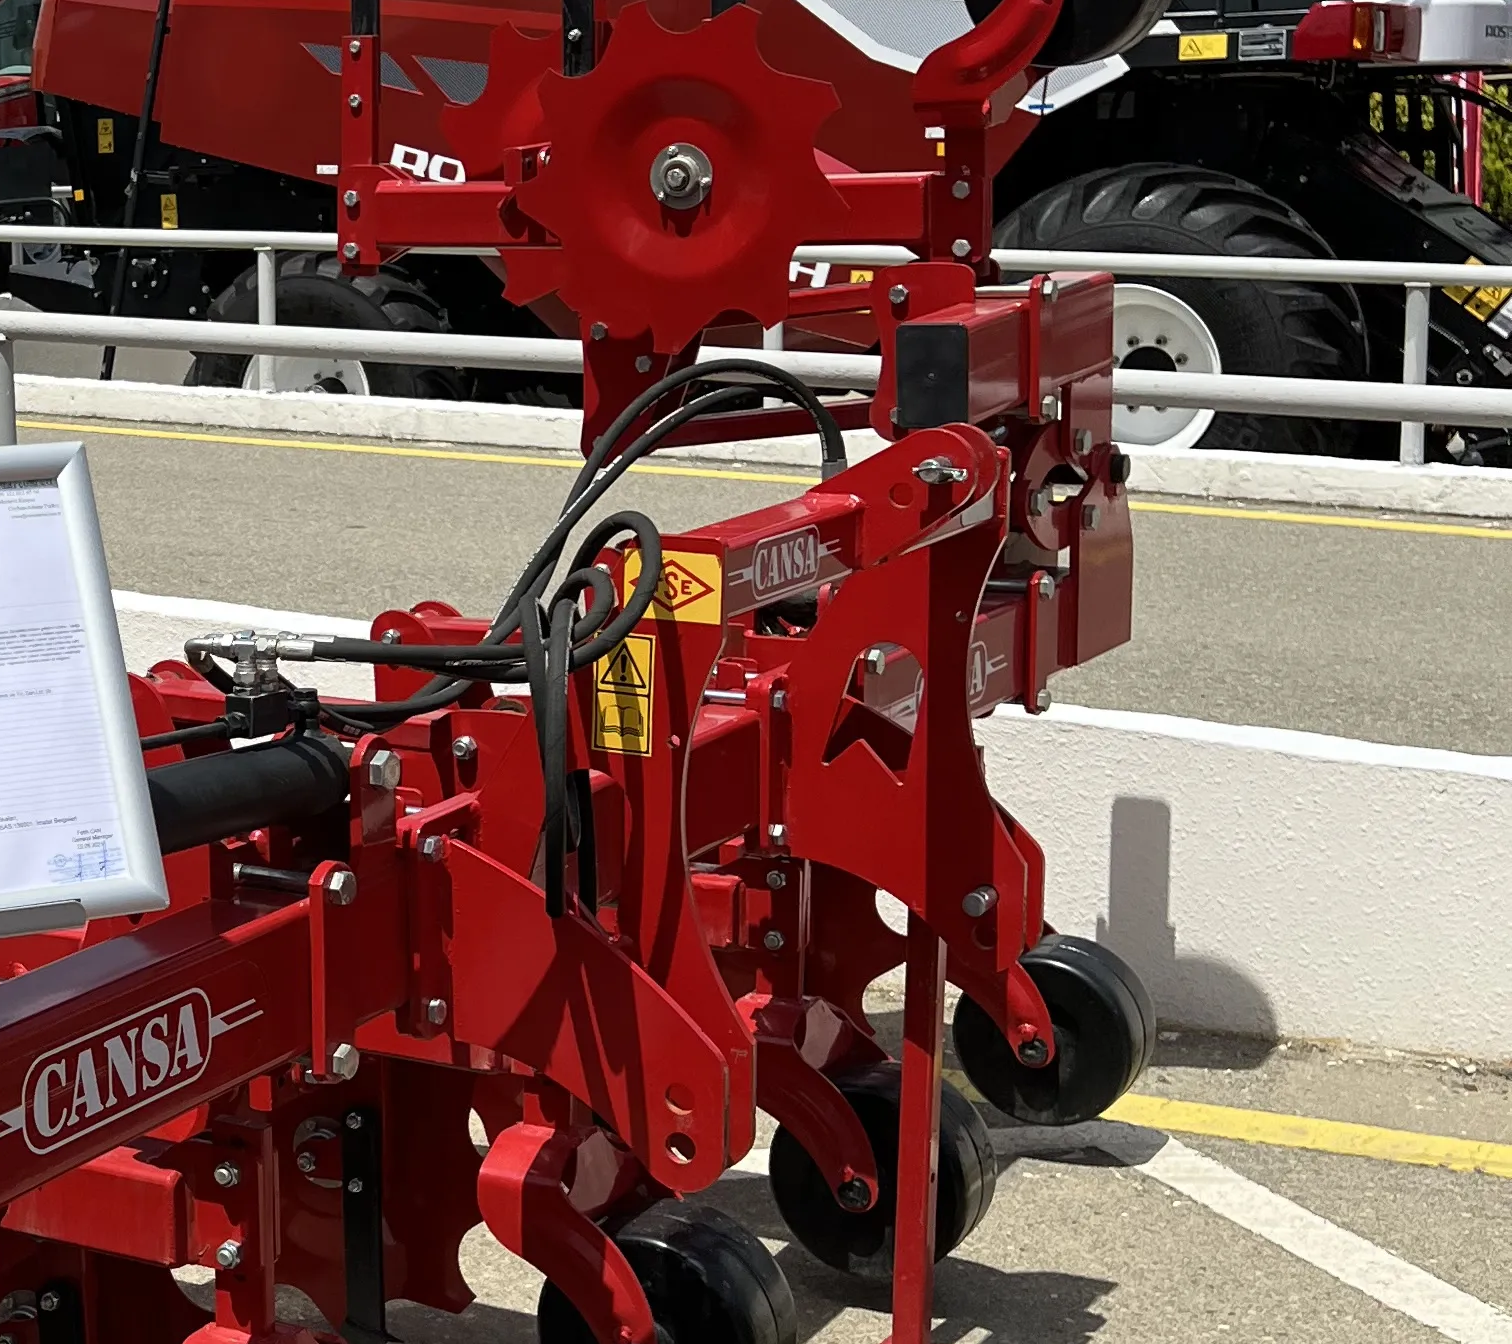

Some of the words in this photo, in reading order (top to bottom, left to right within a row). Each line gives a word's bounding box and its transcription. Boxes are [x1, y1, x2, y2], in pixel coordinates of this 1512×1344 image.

[658, 571, 693, 601] SE
[755, 534, 817, 590] CANSA
[33, 1003, 203, 1137] CANSA
